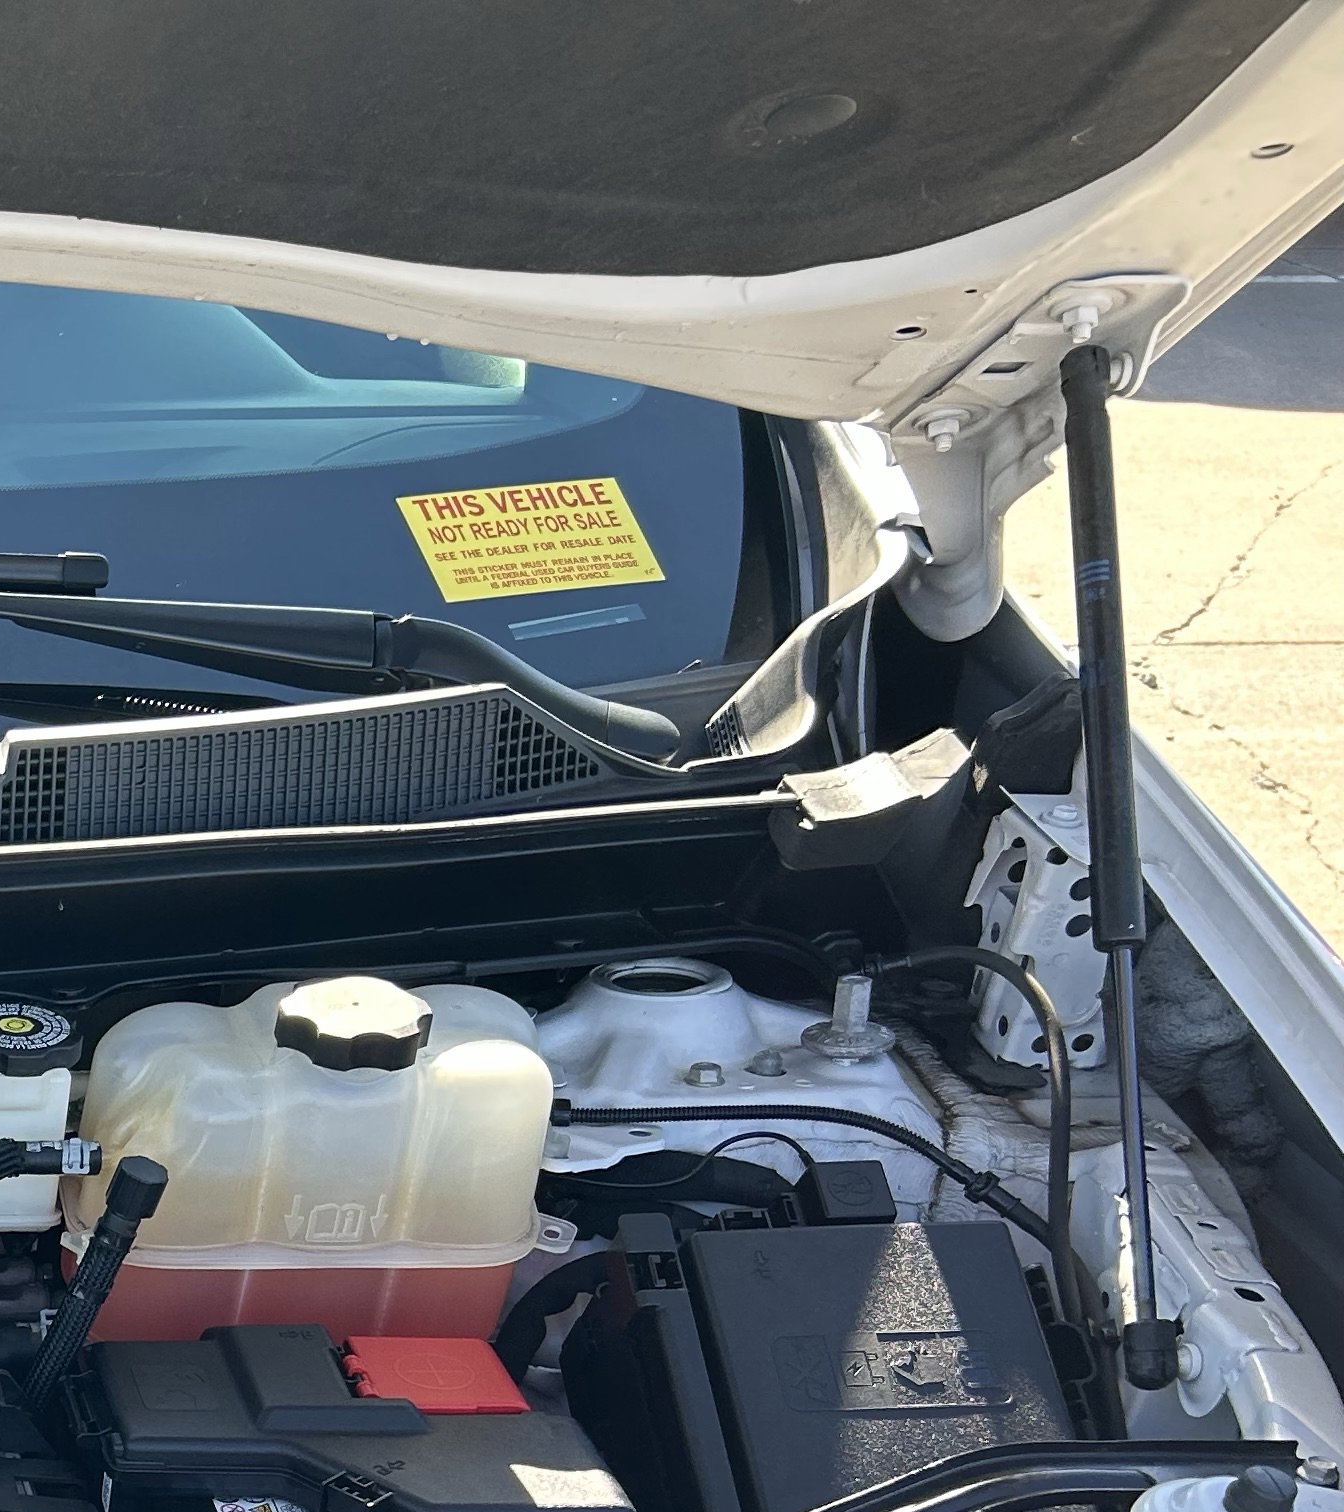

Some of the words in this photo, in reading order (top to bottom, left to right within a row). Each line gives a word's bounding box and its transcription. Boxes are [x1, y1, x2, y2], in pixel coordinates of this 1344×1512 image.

[412, 494, 485, 521] THIS
[485, 483, 613, 514] VEHICLE
[427, 525, 466, 544] NOT
[469, 518, 530, 540] READY
[533, 514, 574, 534] FOR
[574, 510, 622, 530] SALE
[434, 552, 457, 562] SEE
[460, 549, 483, 559] THE
[486, 544, 529, 556] DEALER
[533, 541, 557, 552] FOR
[560, 537, 604, 549] RESALE
[607, 534, 636, 545] DATE
[453, 568, 475, 576] THIS
[477, 563, 518, 573] STICKER
[520, 560, 547, 569] MUST
[552, 556, 589, 566] REMAIN
[603, 552, 634, 561] PLACE
[455, 576, 481, 584] UNTIL
[491, 571, 530, 580] FEDERAL
[531, 568, 555, 577] USED
[577, 562, 611, 572] BUYERS
[612, 560, 639, 569] GUIDE
[502, 578, 538, 588] AFFIXED
[540, 576, 552, 584] TO
[553, 574, 573, 583] THIS
